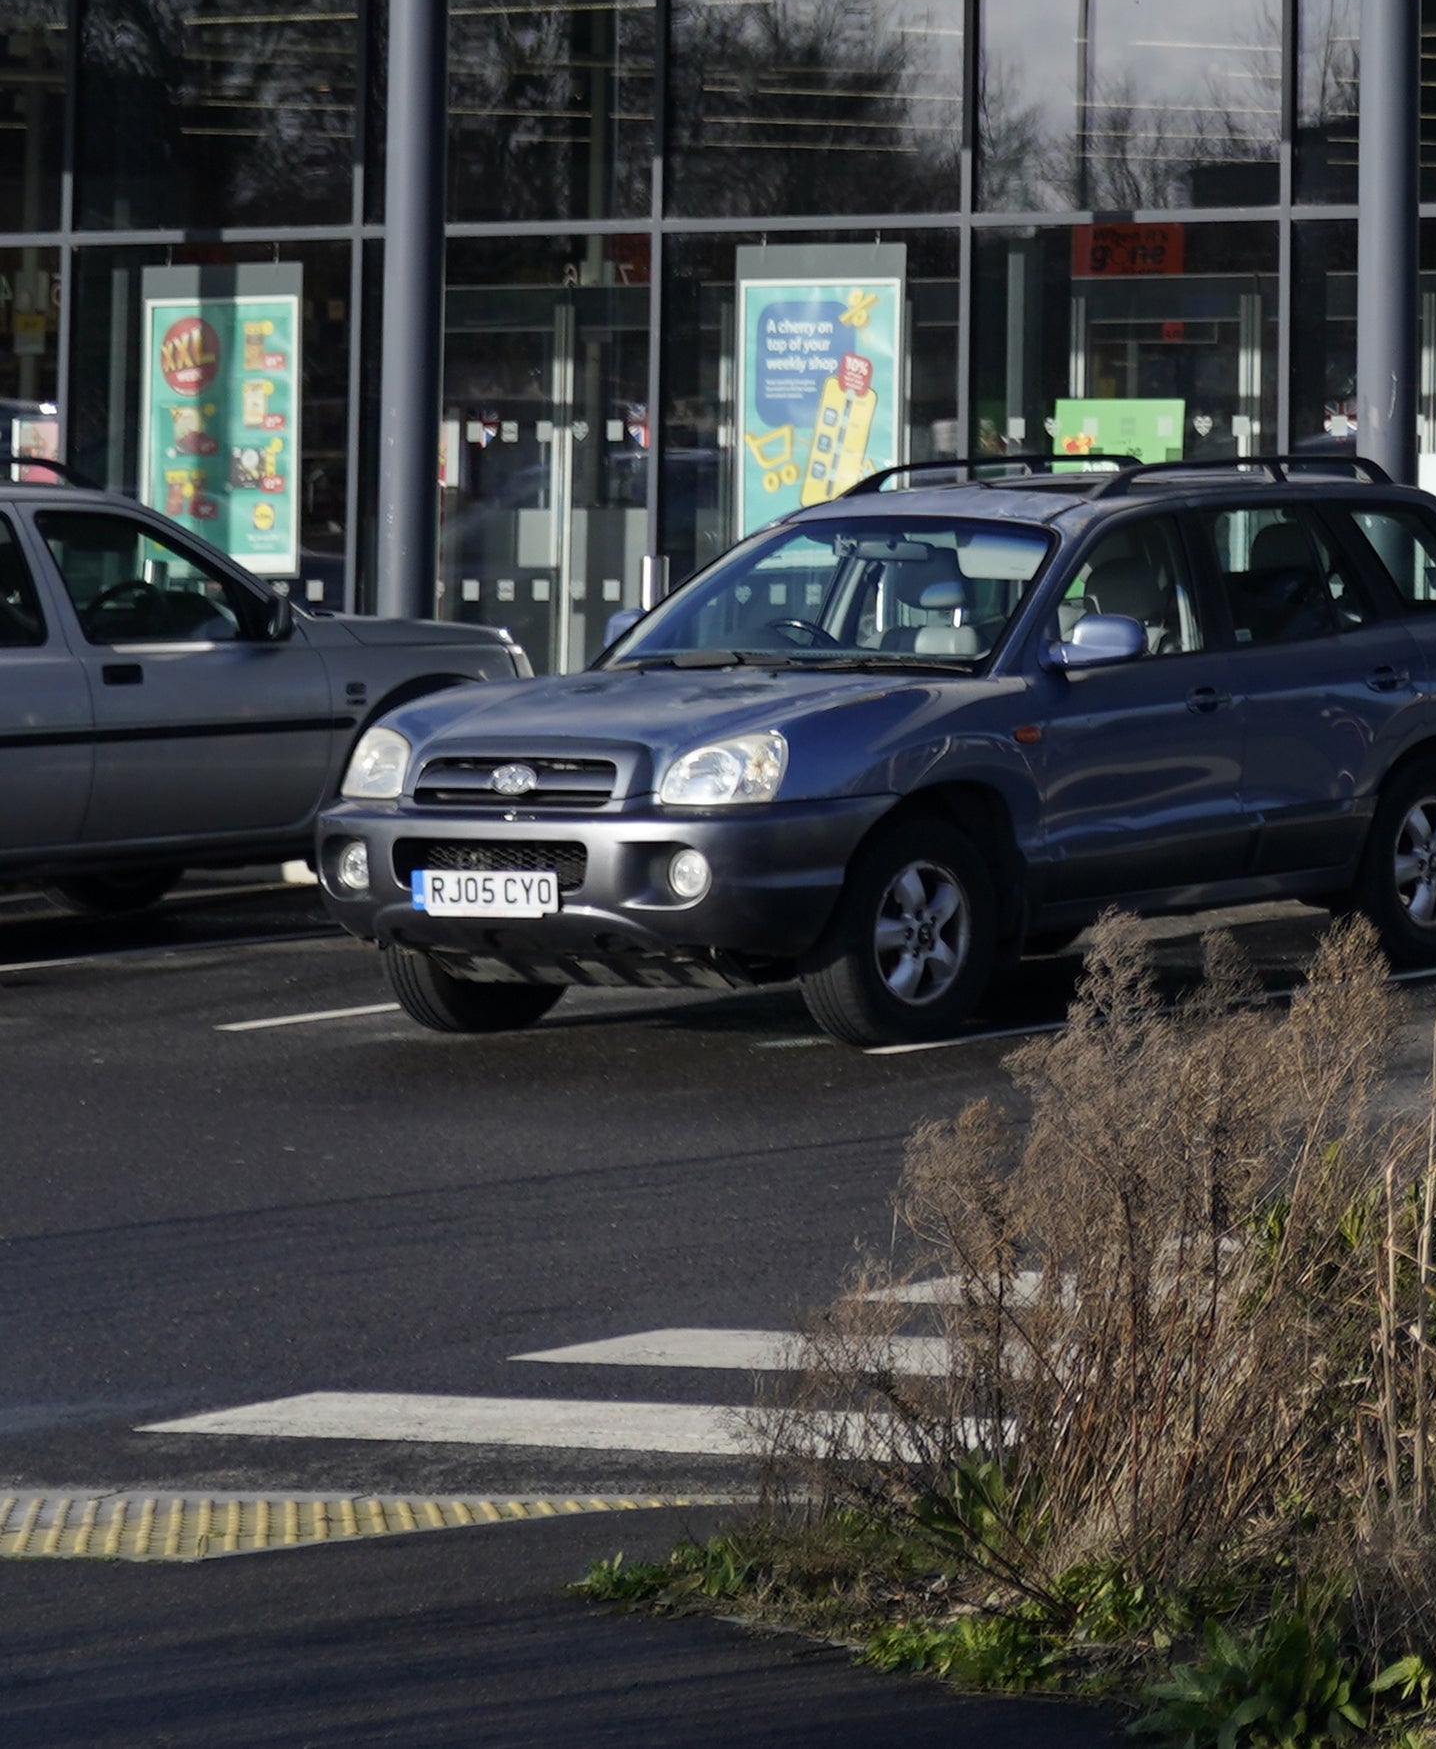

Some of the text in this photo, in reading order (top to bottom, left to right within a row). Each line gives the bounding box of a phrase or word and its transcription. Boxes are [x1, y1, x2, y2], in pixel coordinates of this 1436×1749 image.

[1090, 245, 1166, 272] gone
[766, 318, 834, 337] A cherry on
[161, 326, 216, 372] XXL
[766, 338, 831, 354] top of your
[765, 356, 839, 373] weekly shop
[844, 355, 870, 377] 10%
[431, 876, 552, 904] RJ05 CYO
